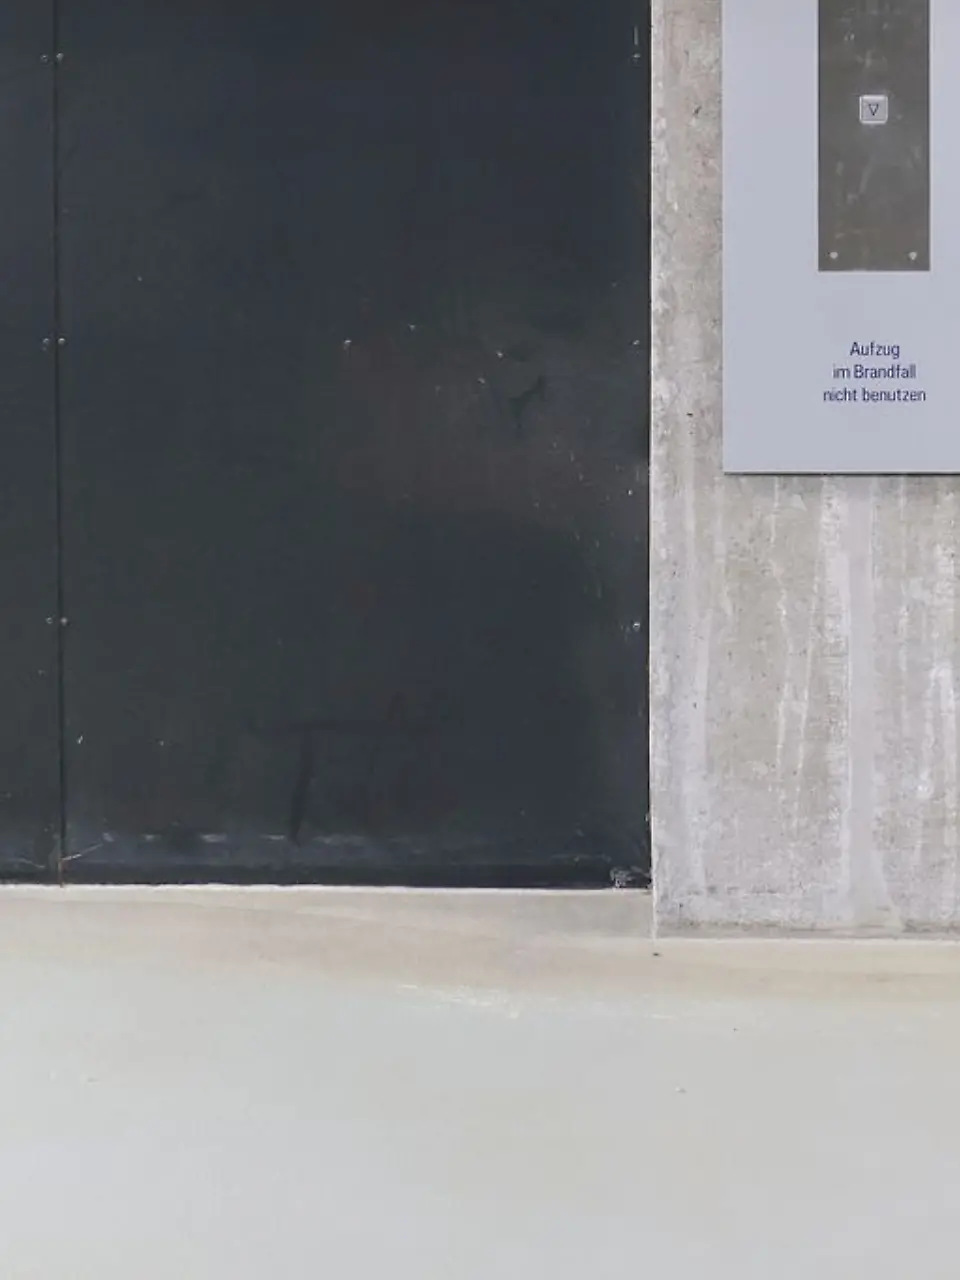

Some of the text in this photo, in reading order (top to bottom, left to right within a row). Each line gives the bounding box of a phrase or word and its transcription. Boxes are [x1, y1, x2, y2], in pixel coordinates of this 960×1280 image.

[849, 341, 900, 360] Aufzug
[832, 364, 917, 380] im Brandfall
[823, 387, 927, 402] nicht benutzen
